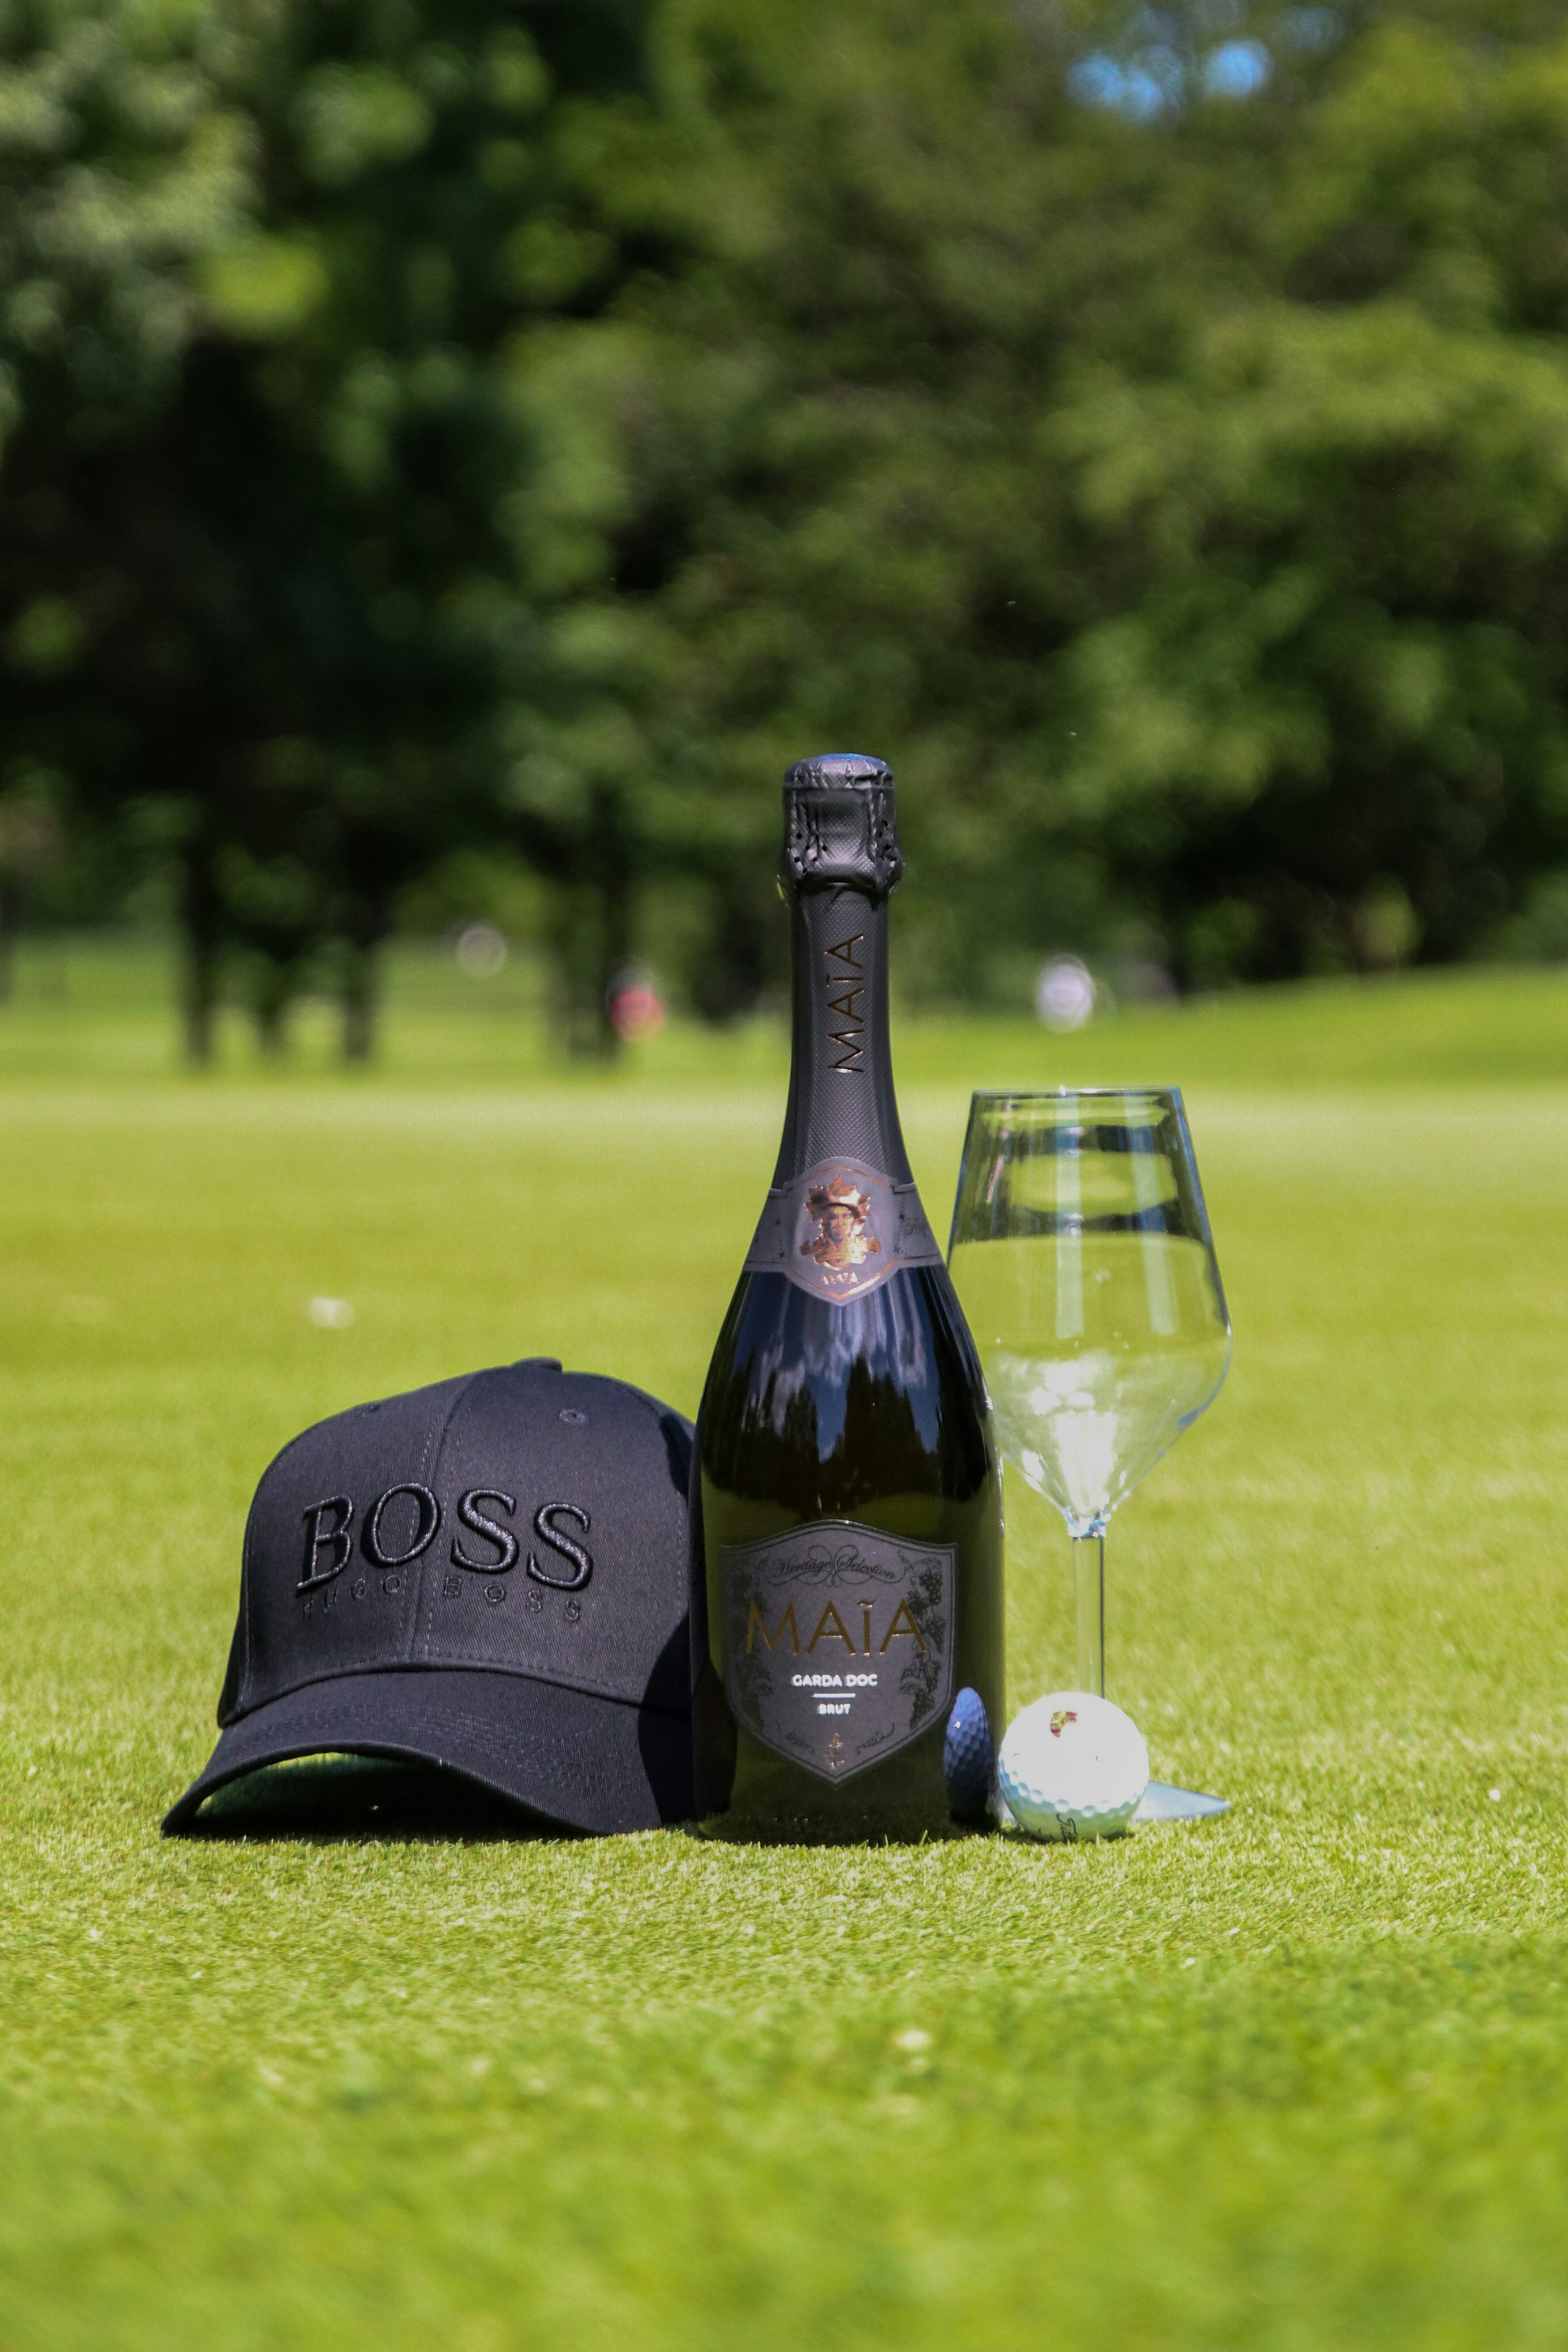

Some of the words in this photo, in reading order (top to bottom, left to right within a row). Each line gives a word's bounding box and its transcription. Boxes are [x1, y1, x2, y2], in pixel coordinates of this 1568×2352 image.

[295, 1482, 594, 1596] BOSS
[773, 1554, 831, 1577] Heritage
[836, 1554, 896, 1580] Selection
[442, 1575, 580, 1622] BOSS
[792, 1674, 843, 1687] GARDA
[845, 1674, 878, 1687] DOC
[817, 1703, 851, 1715] BRUT
